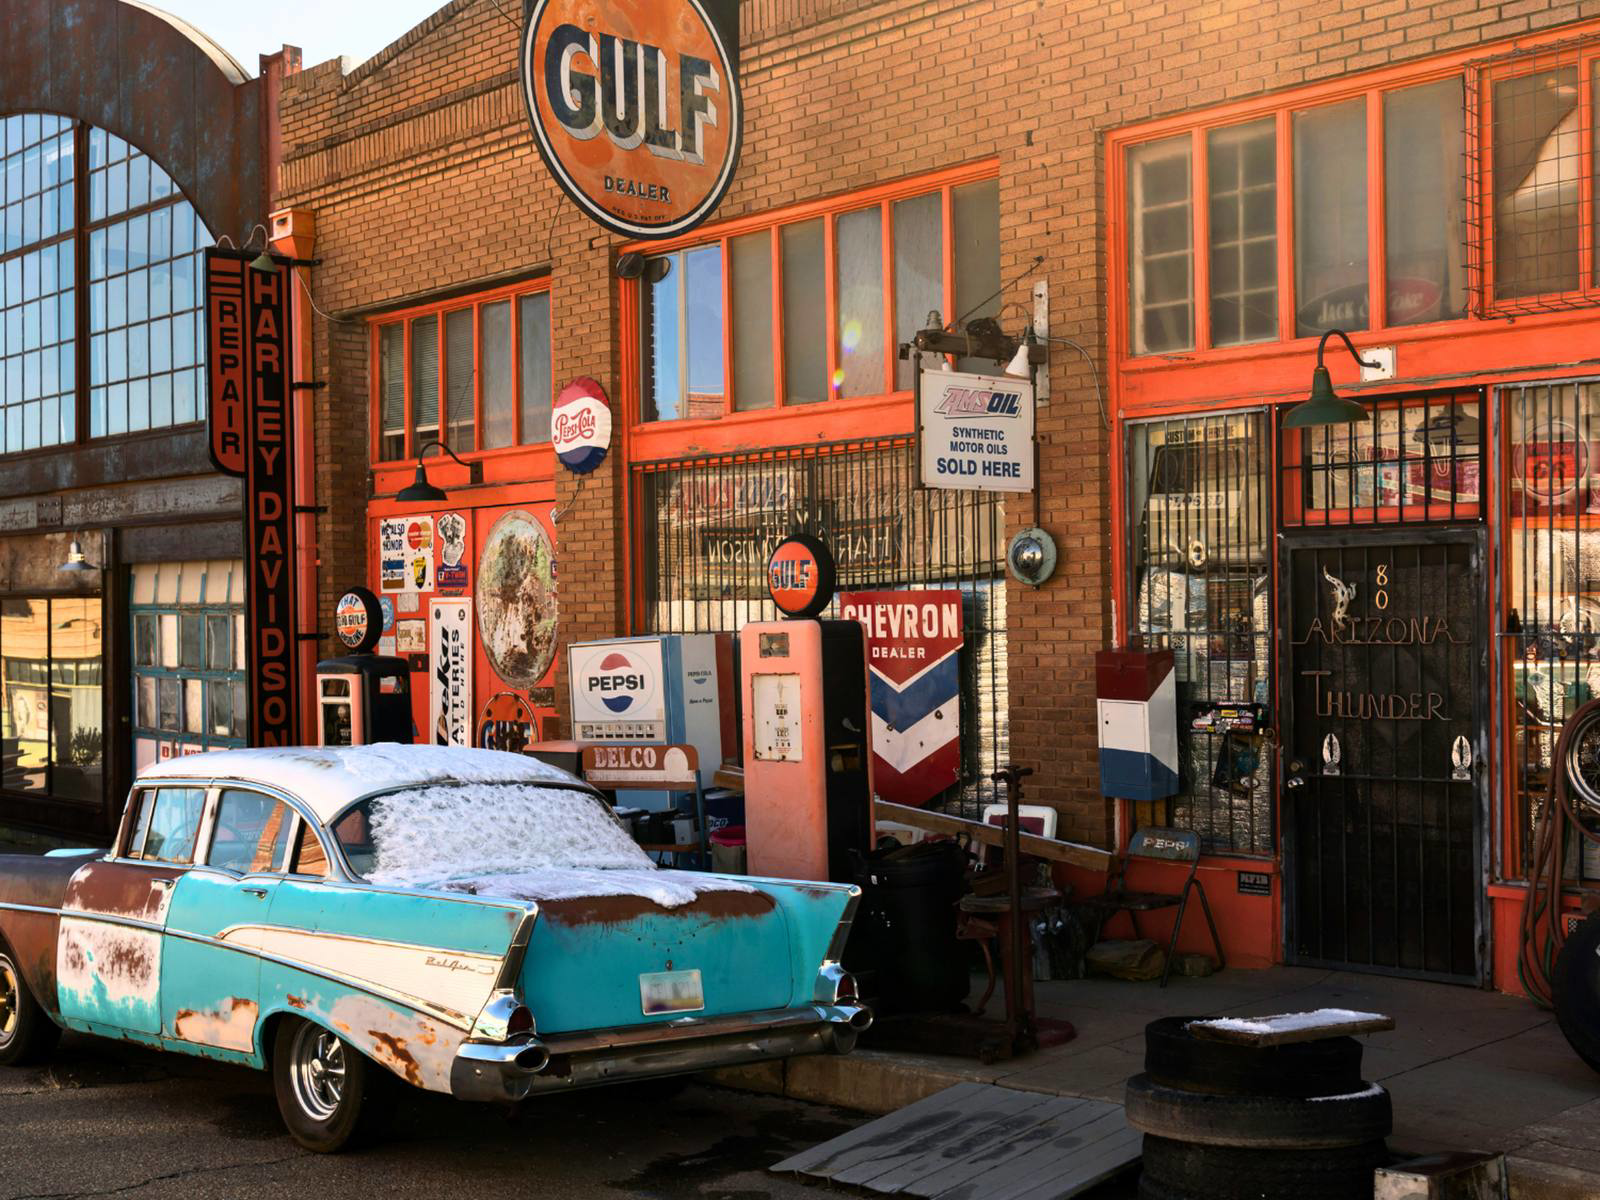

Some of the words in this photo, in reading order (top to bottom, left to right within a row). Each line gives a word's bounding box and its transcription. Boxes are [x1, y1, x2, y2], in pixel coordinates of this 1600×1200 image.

[544, 24, 720, 165] GULF
[604, 176, 672, 204] DEALER
[218, 301, 240, 455] REPAIR
[253, 273, 281, 476] HARLEY
[939, 387, 1019, 416] AMSOIL
[950, 441, 987, 454] MOTOR
[987, 444, 1008, 455] OILS
[952, 427, 1005, 441] SYNTHETIC
[1166, 430, 1195, 443] CUSTM
[937, 458, 977, 476] SOLD
[982, 461, 1021, 477] HERE
[383, 539, 403, 551] HONOR
[771, 560, 812, 590] GULF
[258, 491, 288, 748] DAVIDSON
[844, 603, 959, 639] CHEVRON
[1300, 616, 1458, 645] ARIZONA
[872, 647, 926, 659] DEALER
[588, 674, 645, 692] PEPSI
[1301, 670, 1452, 721] THUNDER
[594, 747, 657, 768] DELCO
